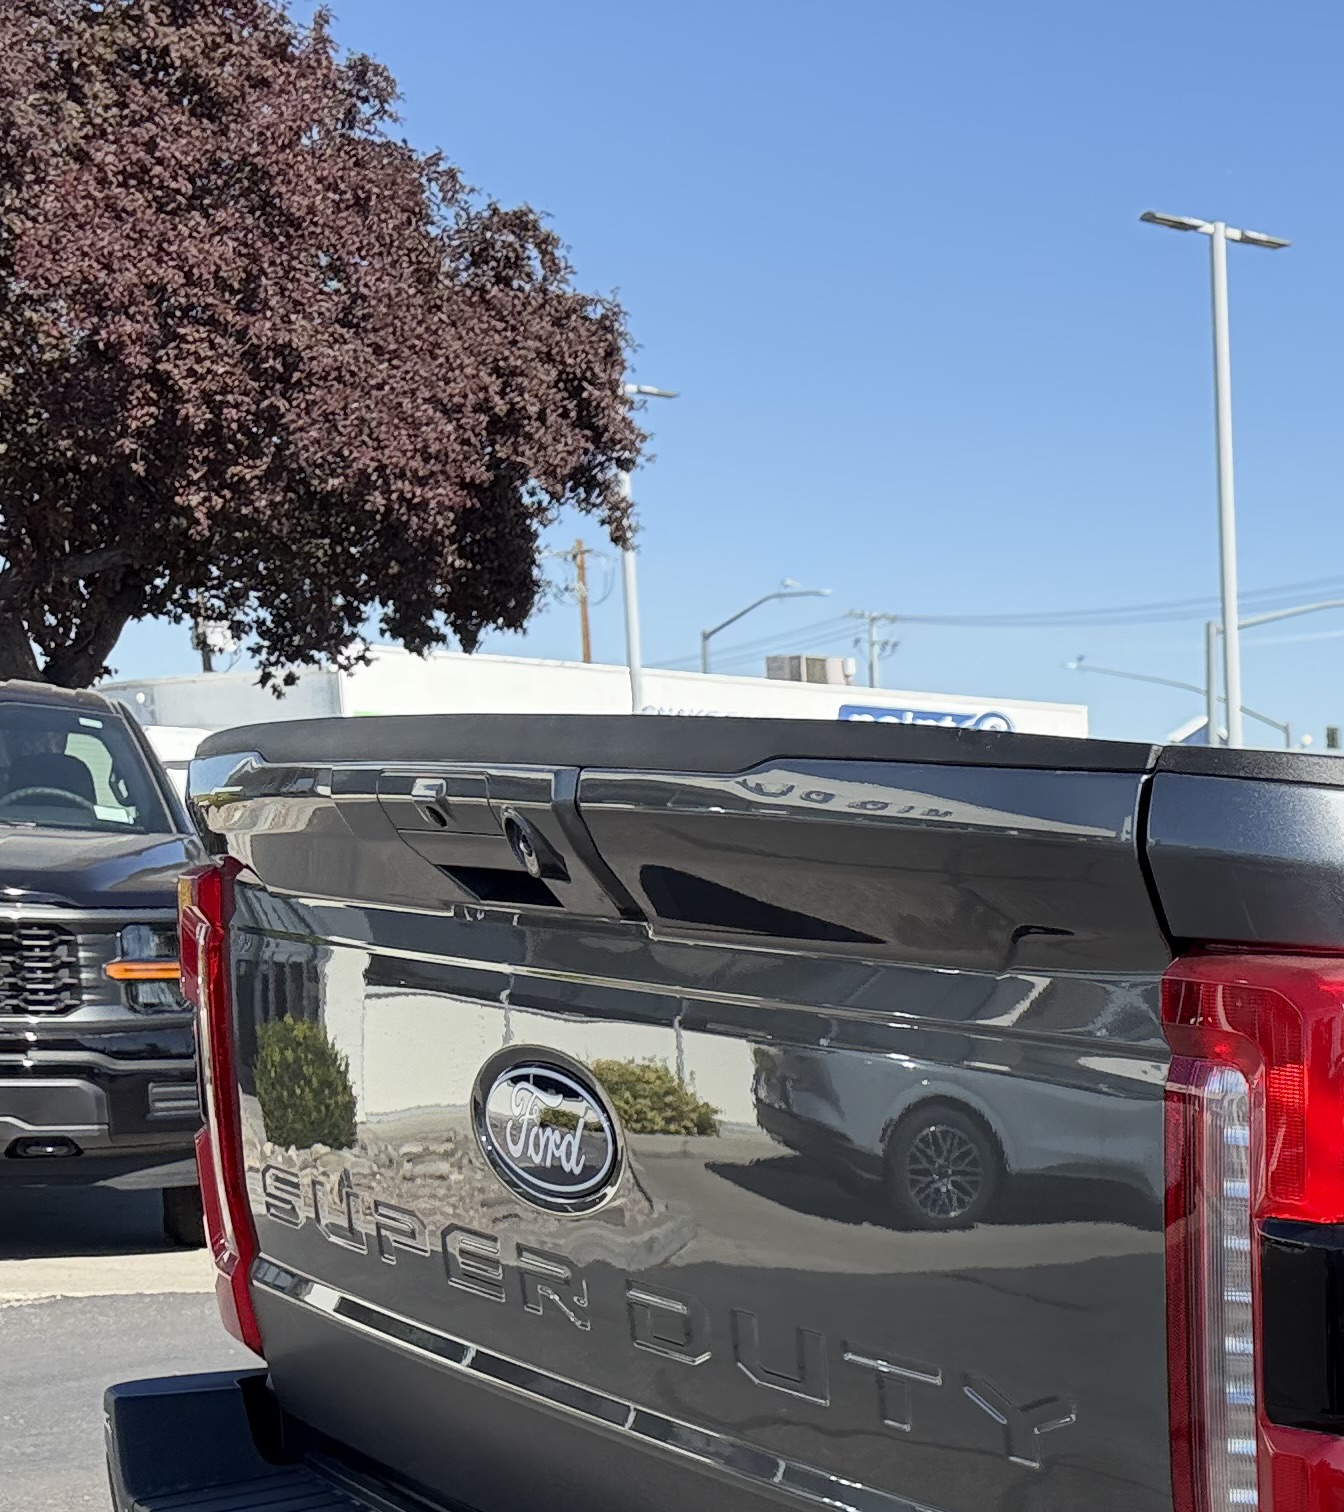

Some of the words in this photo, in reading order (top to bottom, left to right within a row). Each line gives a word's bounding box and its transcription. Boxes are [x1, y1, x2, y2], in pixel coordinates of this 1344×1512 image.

[506, 1081, 585, 1176] Ford
[262, 1163, 592, 1331] SUPER
[626, 1278, 1077, 1470] DUTY
